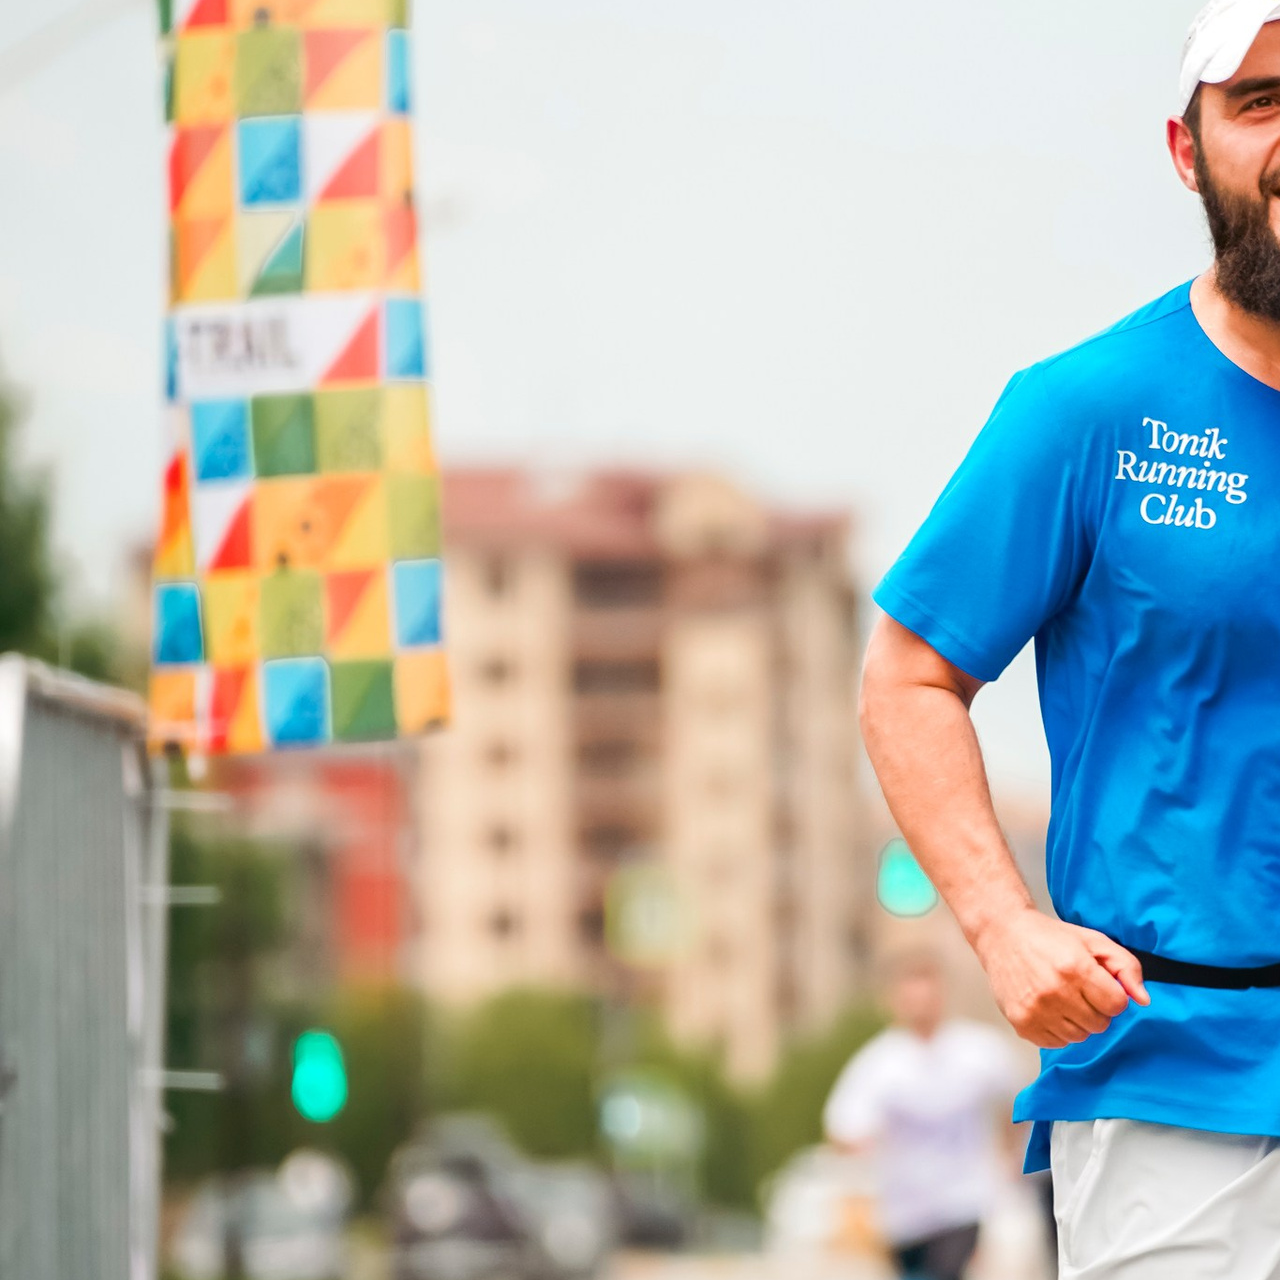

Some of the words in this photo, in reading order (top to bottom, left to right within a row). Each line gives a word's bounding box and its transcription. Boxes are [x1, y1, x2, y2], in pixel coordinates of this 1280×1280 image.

[188, 316, 299, 369] TRAIL
[1142, 417, 1228, 459] Tonik
[1115, 450, 1249, 504] Running
[1140, 493, 1217, 529] Club
